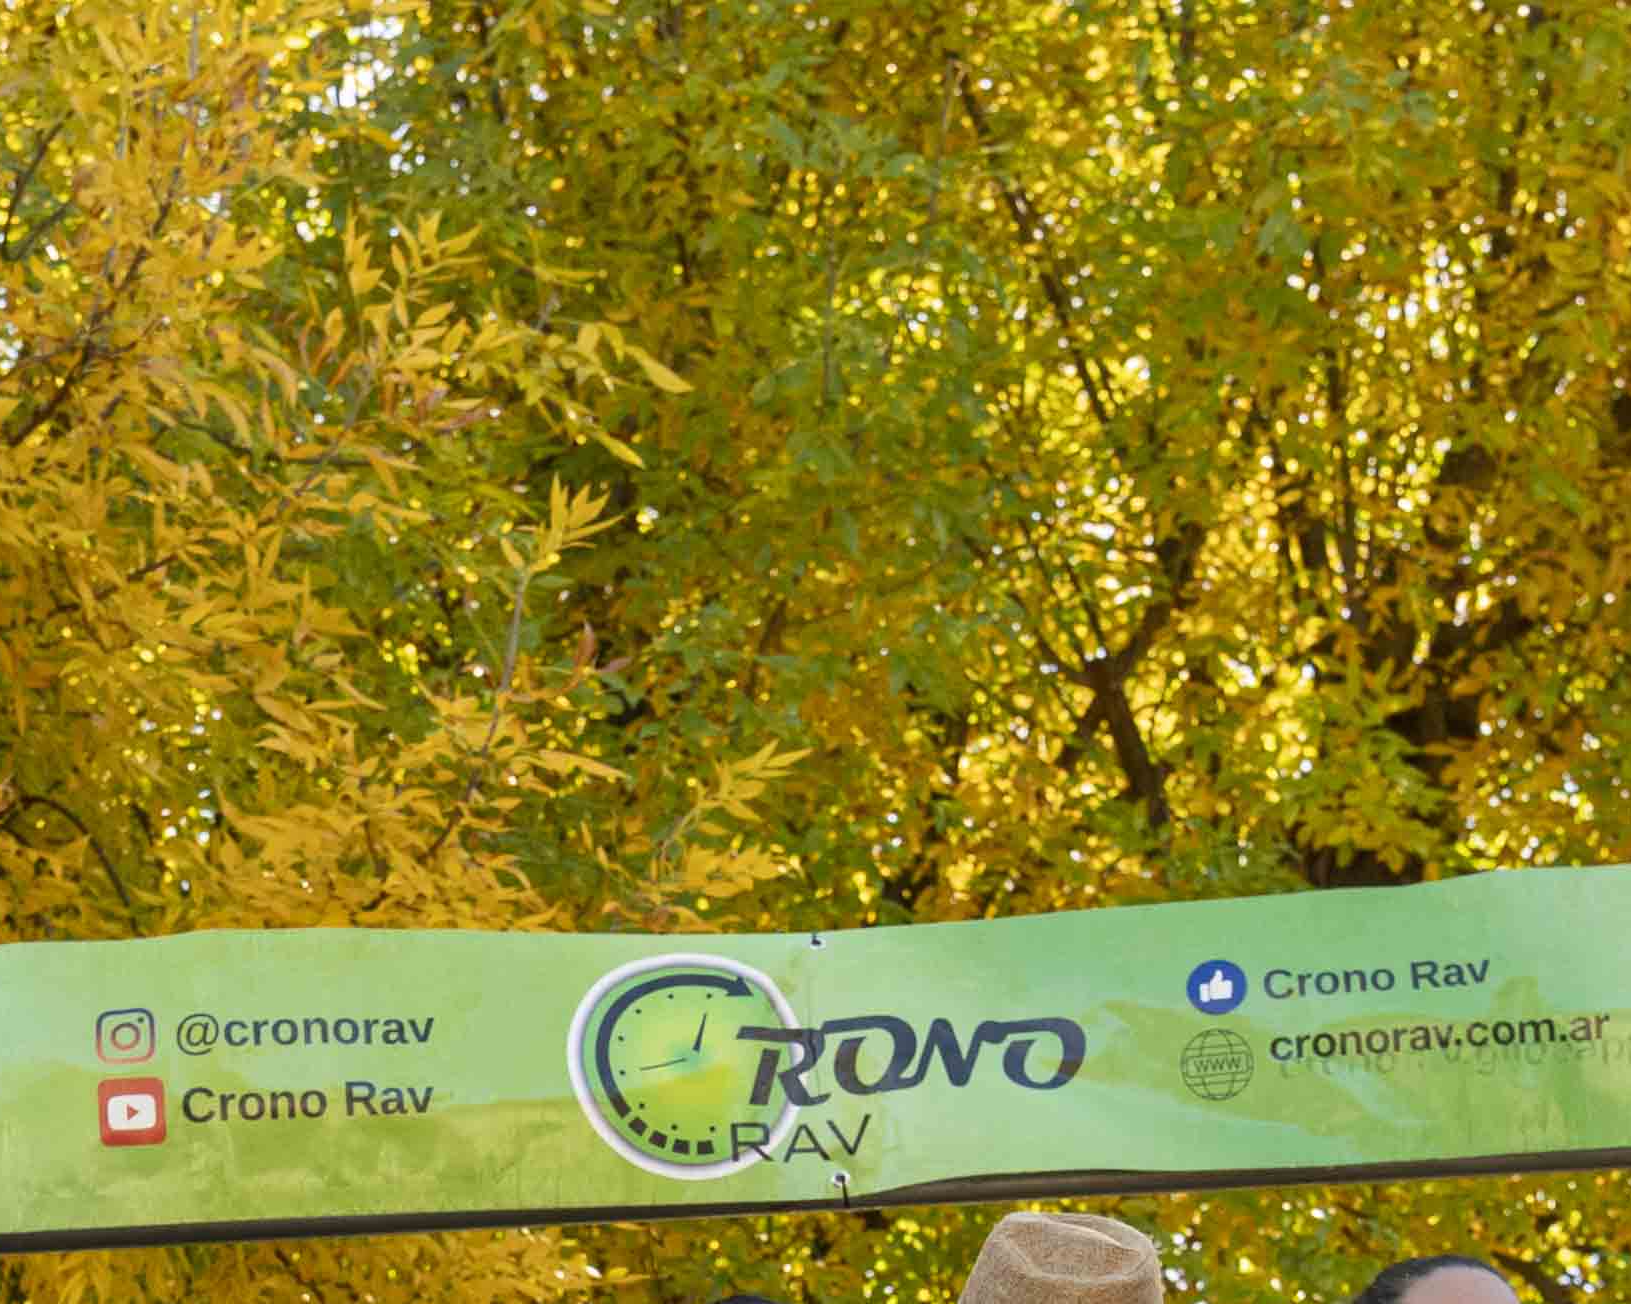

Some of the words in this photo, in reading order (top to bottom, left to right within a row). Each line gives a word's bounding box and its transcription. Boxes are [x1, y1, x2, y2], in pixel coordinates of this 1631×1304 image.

[1263, 964, 1396, 1001] Crono
[1410, 958, 1490, 991] Rav
[176, 1008, 434, 1056] @cronorav
[1269, 1012, 1610, 1062] cronorav.com.ar
[182, 1084, 330, 1127] Crono
[345, 1080, 433, 1119] Rav
[731, 1114, 872, 1162] RAV
